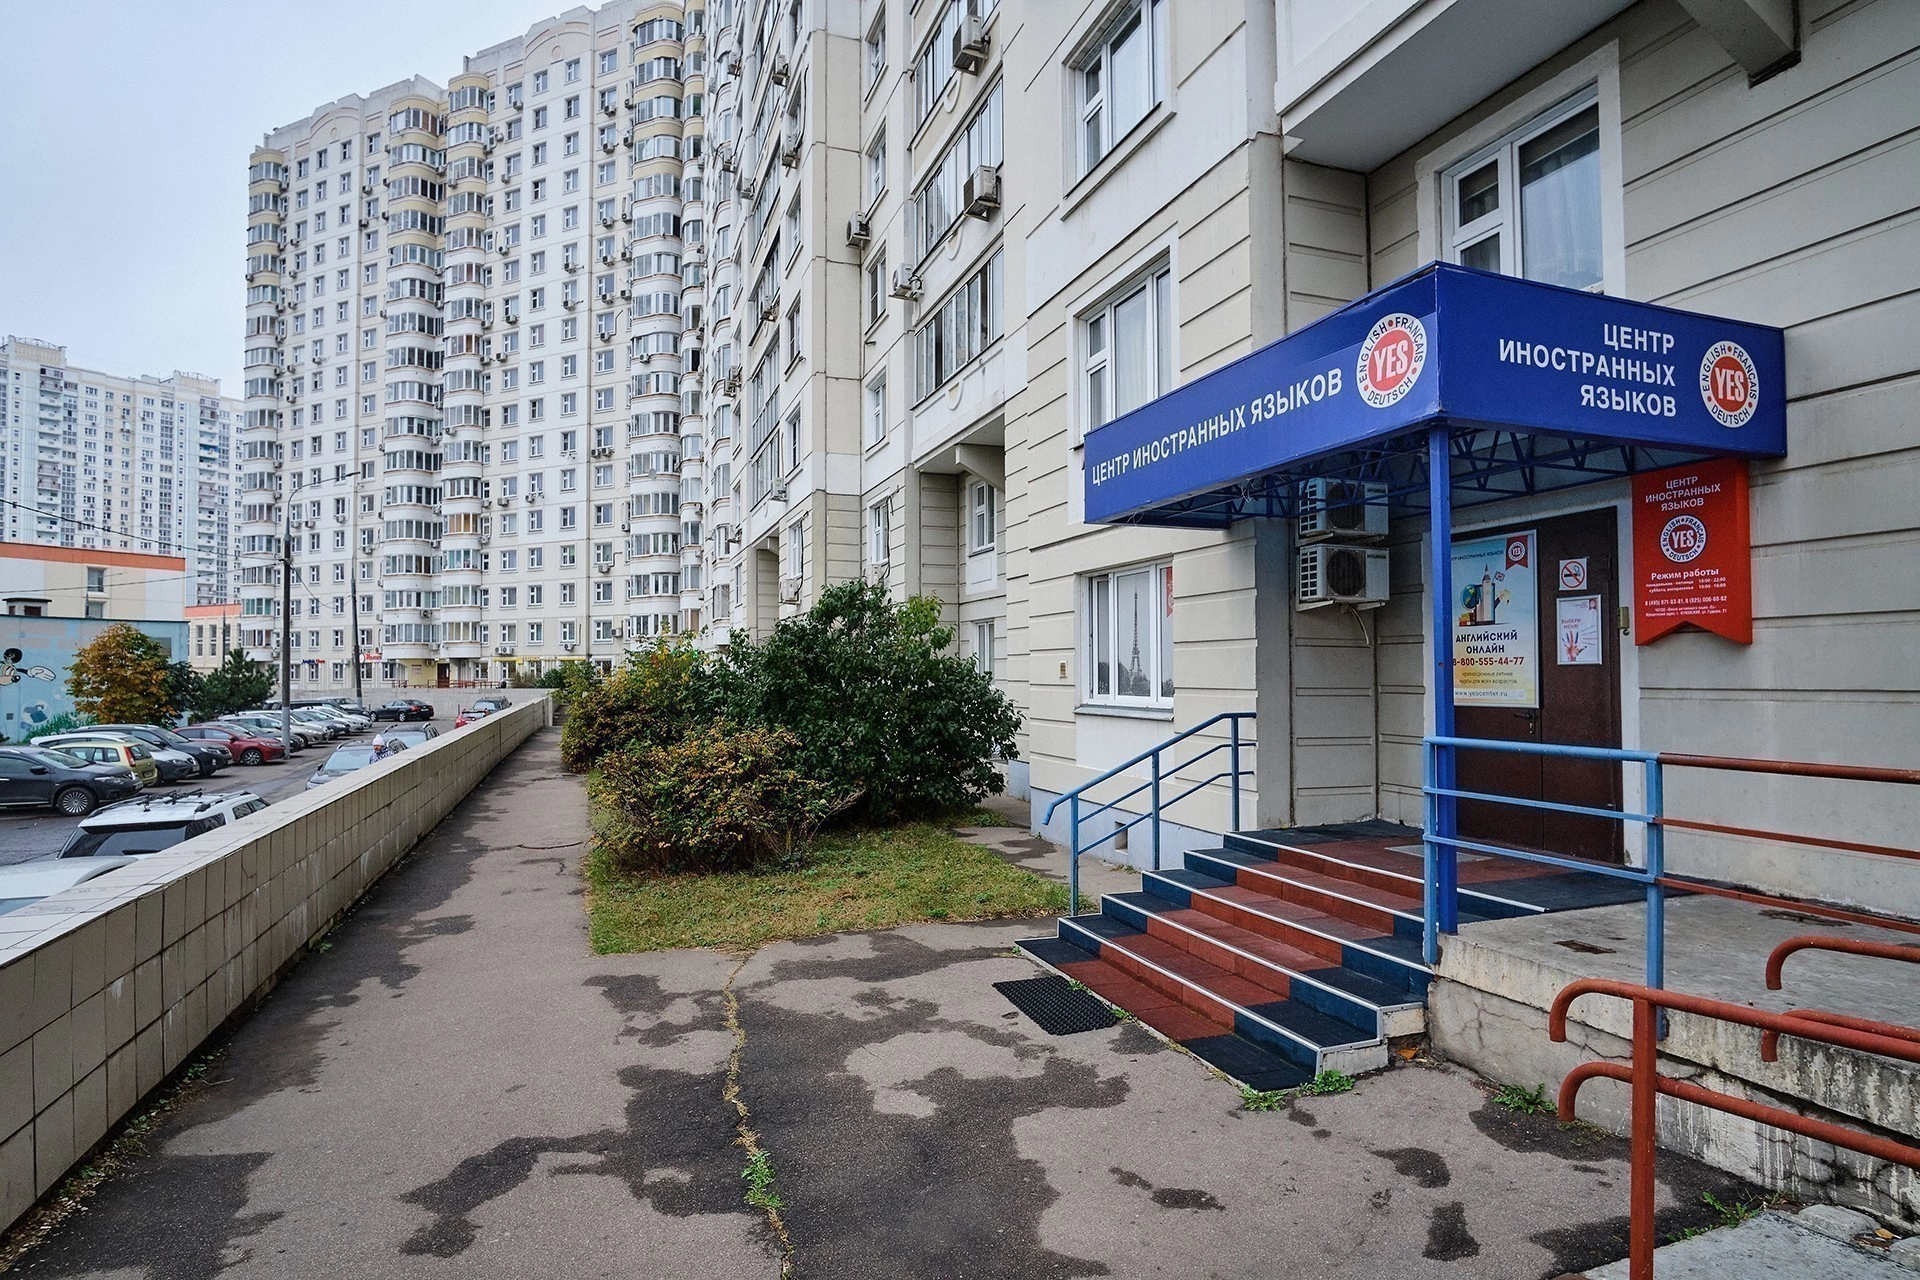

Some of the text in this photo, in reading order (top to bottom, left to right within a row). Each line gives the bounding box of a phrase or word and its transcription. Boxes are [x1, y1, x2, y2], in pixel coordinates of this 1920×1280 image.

[1359, 322, 1388, 384] ENGLISH
[1395, 316, 1424, 363] FRANÇAIS
[1603, 323, 1675, 355] ЦЕНТР
[1373, 339, 1409, 383] YES
[1499, 338, 1676, 387] ИНОСТРАННЫХ
[1701, 344, 1727, 392] ENGLISH
[1367, 376, 1413, 406] DEUTSCH
[1714, 367, 1745, 402] YES
[1580, 384, 1677, 418] ЯЗЫКОВ
[1711, 404, 1751, 425] DEUTSCH
[1092, 367, 1343, 486] ЦЕНТР ИНОСТРАННЫХ ЯЗЫКОВ
[1645, 483, 1721, 503] ИНОСТРАННЫХ
[1665, 476, 1698, 489] ЦЕНТР
[1660, 497, 1704, 512] ЯЗЫКОВ
[1661, 518, 1681, 548] ENGLISH
[1671, 529, 1694, 549] YES
[1668, 548, 1699, 561] DEUTSCH
[1651, 568, 1719, 580] Режим работы
[1456, 629, 1518, 643] АНГЛИЙСКИЙ
[1466, 642, 1505, 654] ОНЛАЙН
